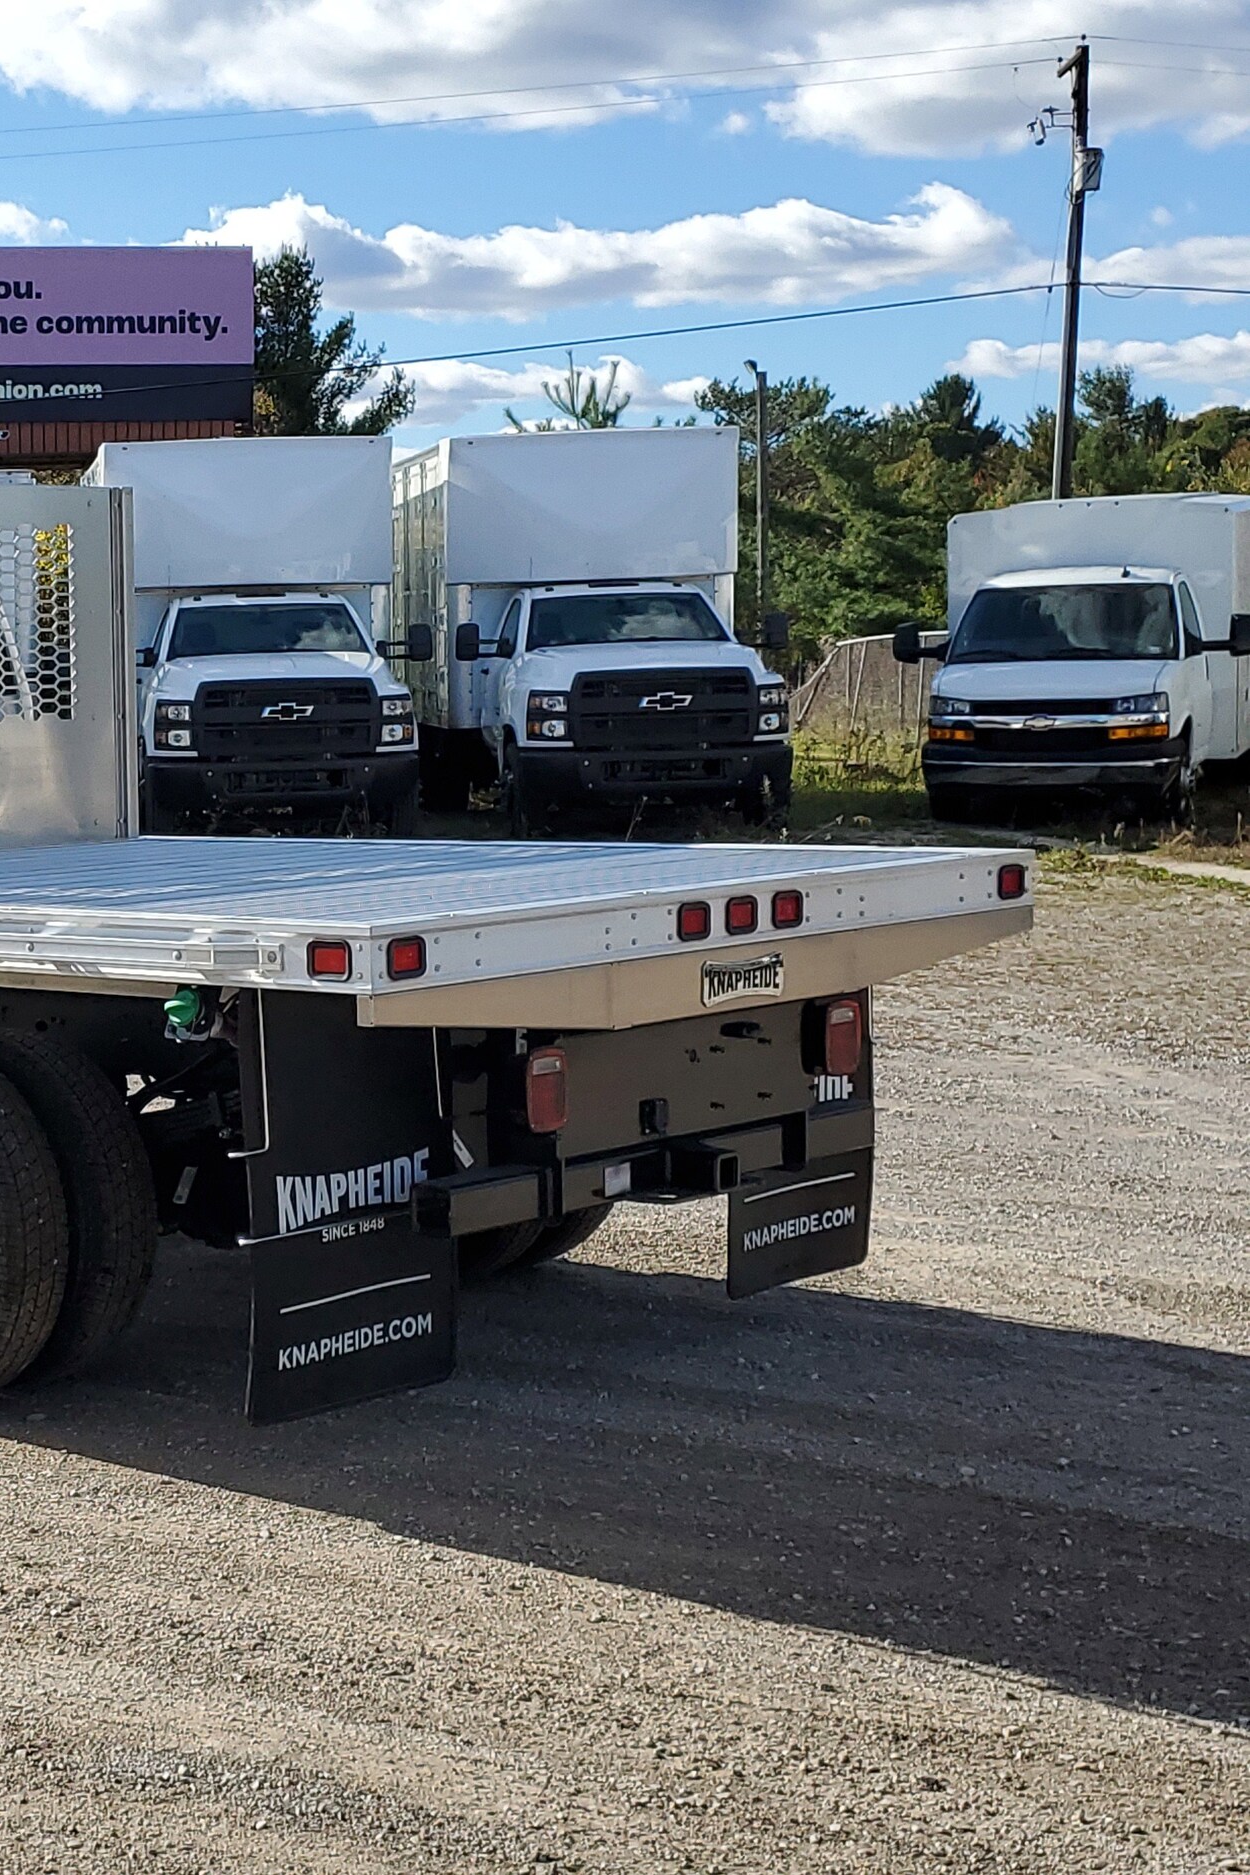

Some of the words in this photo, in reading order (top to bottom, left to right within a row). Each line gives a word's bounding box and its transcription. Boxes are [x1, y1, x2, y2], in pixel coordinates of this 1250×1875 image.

[36, 309, 228, 341] community.
[708, 965, 780, 1000] KNAPHEIDE
[276, 1147, 429, 1234] KNAPHEIDE
[322, 1223, 356, 1243] SINCE
[359, 1217, 385, 1236] 1848
[743, 1205, 856, 1252] KNAPHEIDE.COM
[278, 1312, 433, 1371] KNAPHEIDE.COM
